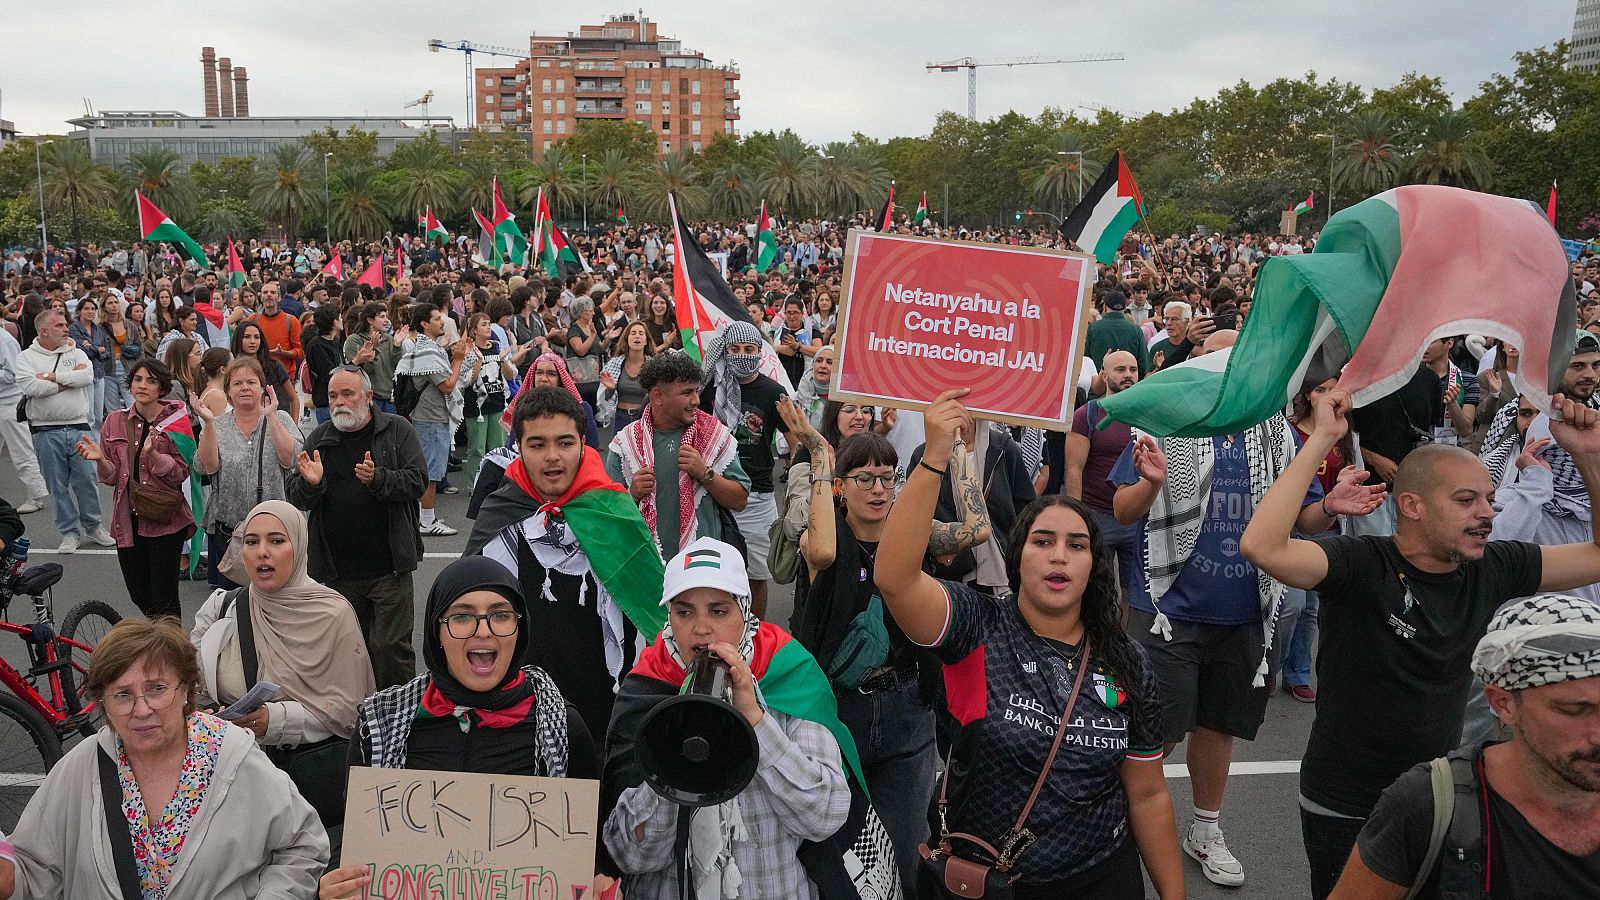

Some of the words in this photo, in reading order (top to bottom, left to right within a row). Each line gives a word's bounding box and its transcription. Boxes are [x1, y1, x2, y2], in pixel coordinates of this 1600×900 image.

[884, 282, 1002, 314] Netanyahu
[1004, 300, 1017, 317] a
[1021, 298, 1040, 319] la
[904, 311, 951, 336] Cort
[954, 316, 1015, 343] Penal
[868, 332, 1005, 367] Internacional
[1008, 351, 1045, 373] JA!
[1214, 447, 1245, 461] ERICA
[1213, 521, 1246, 534] FRANC
[1191, 553, 1221, 577] EST
[1224, 560, 1256, 579] COA
[1004, 708, 1043, 732] BANK
[1045, 725, 1058, 737] O
[1066, 734, 1129, 750] PALESTINE
[365, 780, 471, 838] FCK
[489, 782, 592, 851] ISRL
[362, 863, 445, 900] LONG
[447, 867, 508, 900] LIVE
